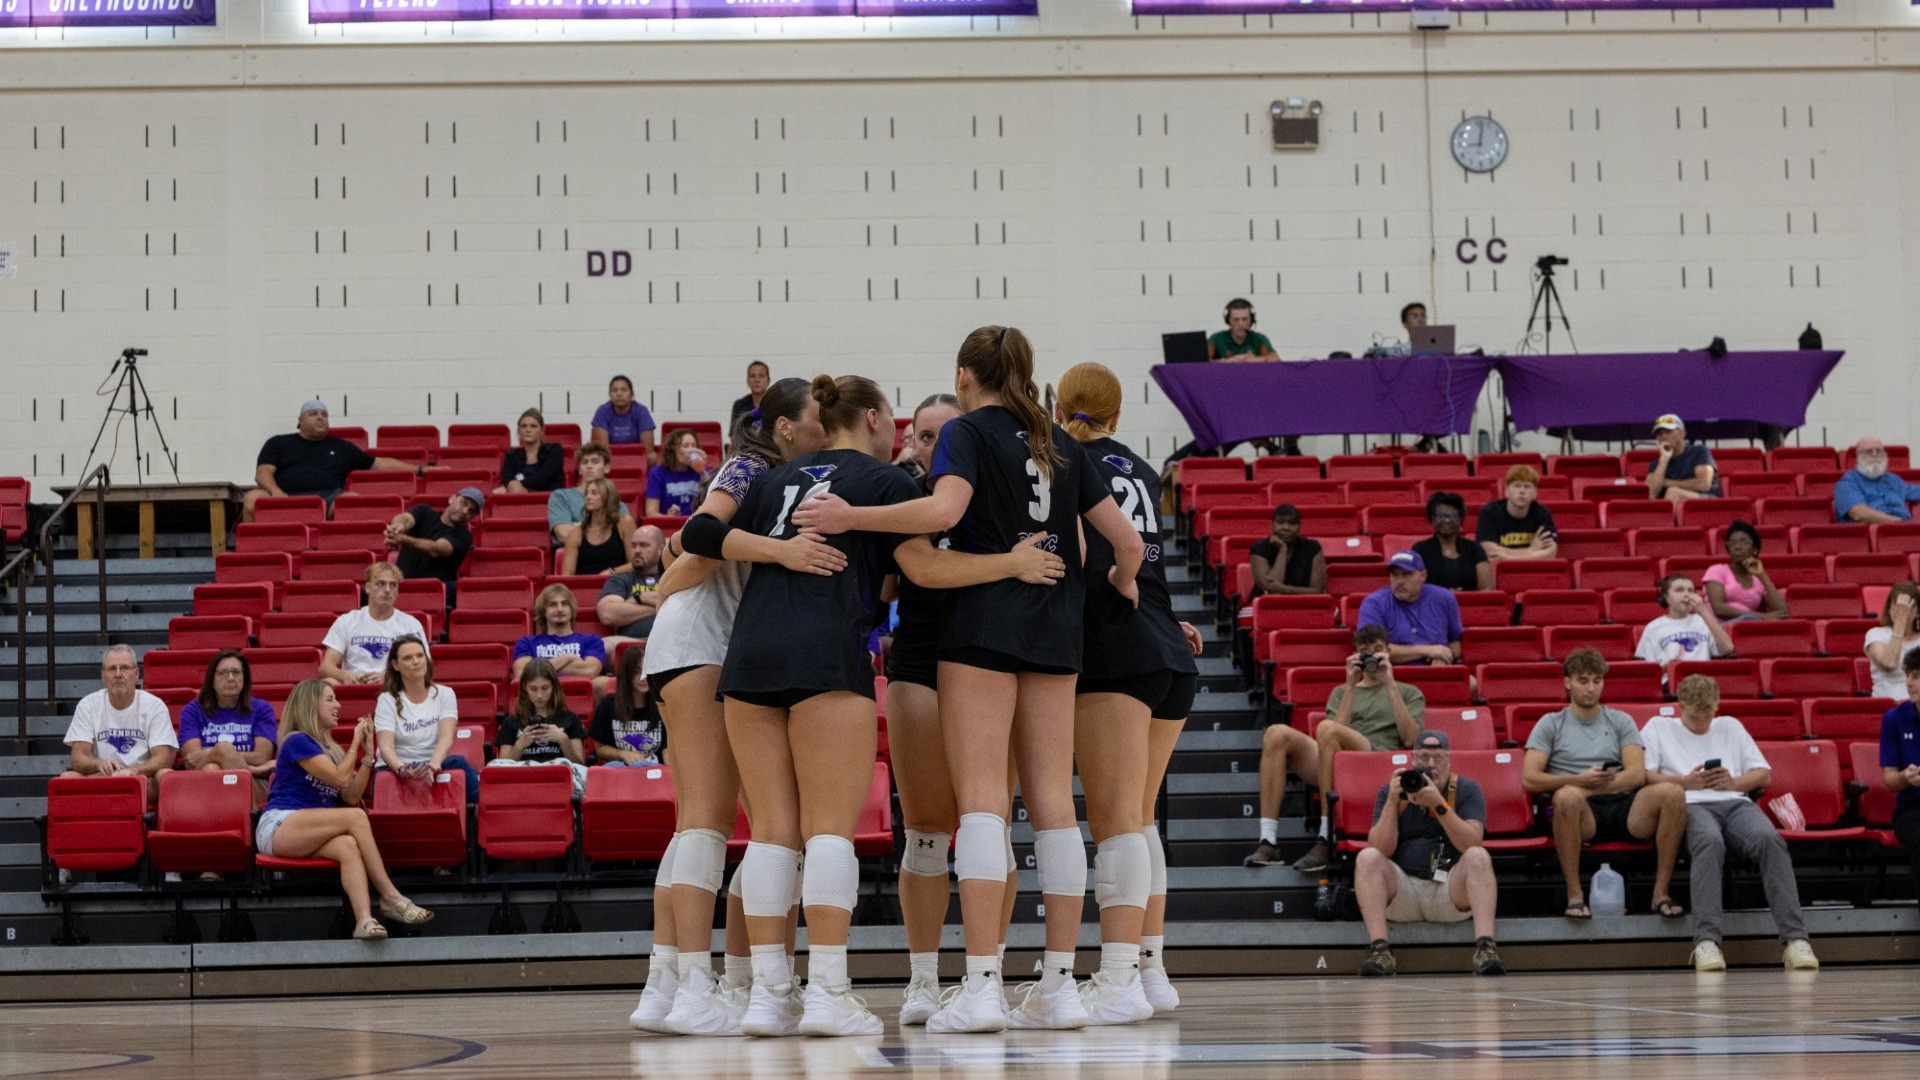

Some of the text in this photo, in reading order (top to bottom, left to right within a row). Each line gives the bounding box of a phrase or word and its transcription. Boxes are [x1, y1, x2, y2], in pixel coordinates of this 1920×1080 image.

[1026, 457, 1051, 522] 3
[1111, 476, 1158, 533] 21
[1231, 761, 1239, 773] E
[1018, 809, 1027, 821] D
[1243, 805, 1253, 817] D
[1026, 855, 1036, 867] C
[1037, 904, 1046, 917] B
[1274, 902, 1284, 914] B
[7, 928, 16, 940] B
[1033, 959, 1044, 972] A
[1316, 956, 1328, 969] A
